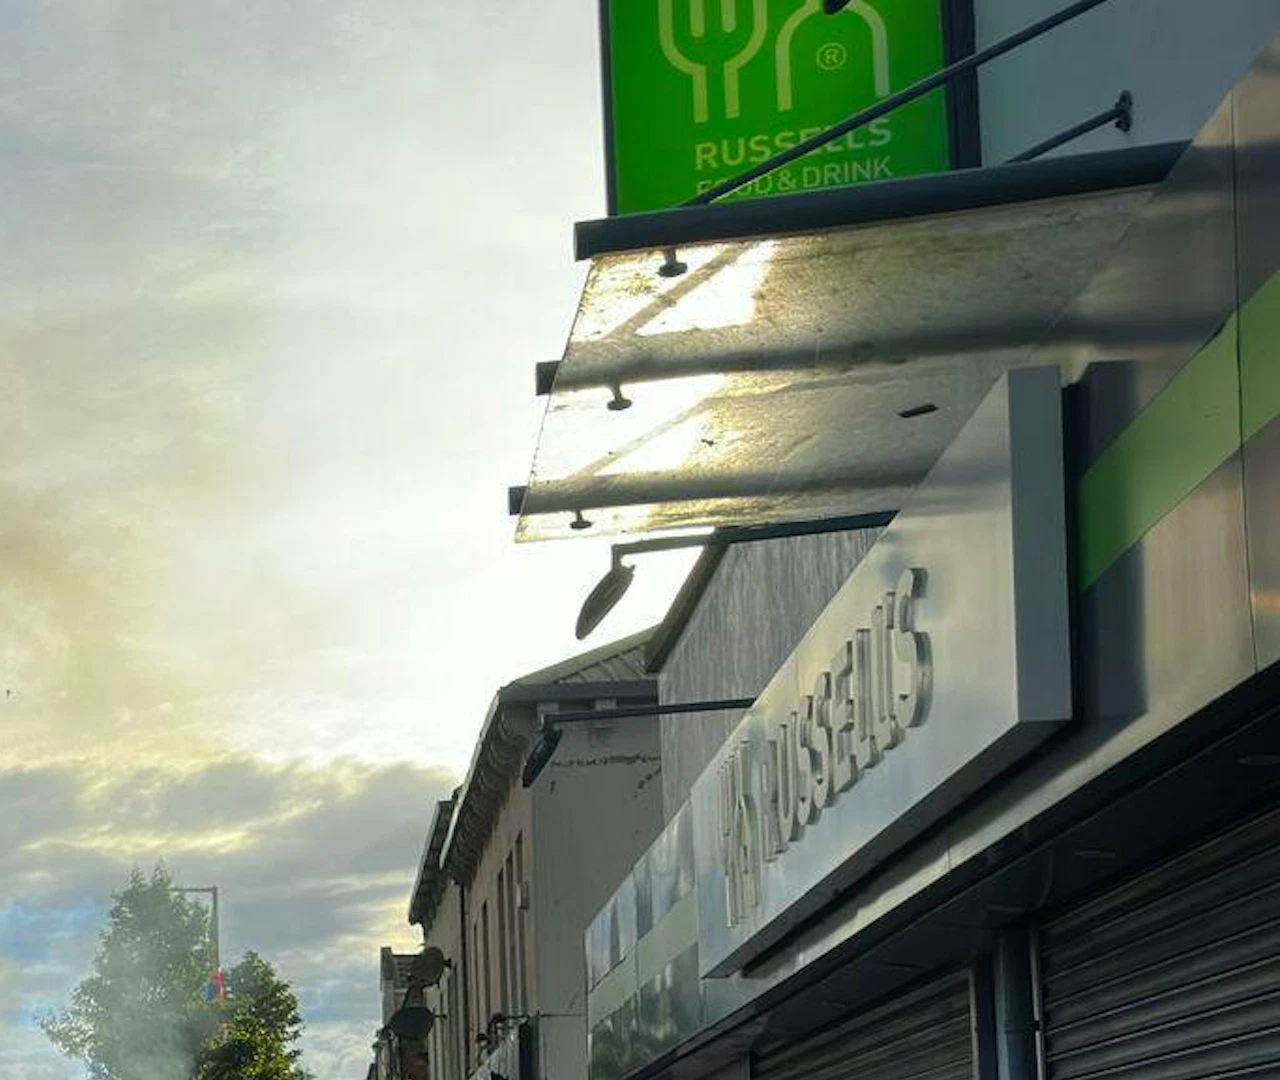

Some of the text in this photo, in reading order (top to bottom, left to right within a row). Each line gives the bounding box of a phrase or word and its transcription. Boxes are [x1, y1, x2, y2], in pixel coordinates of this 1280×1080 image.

[696, 155, 893, 197] FOD & DRINK
